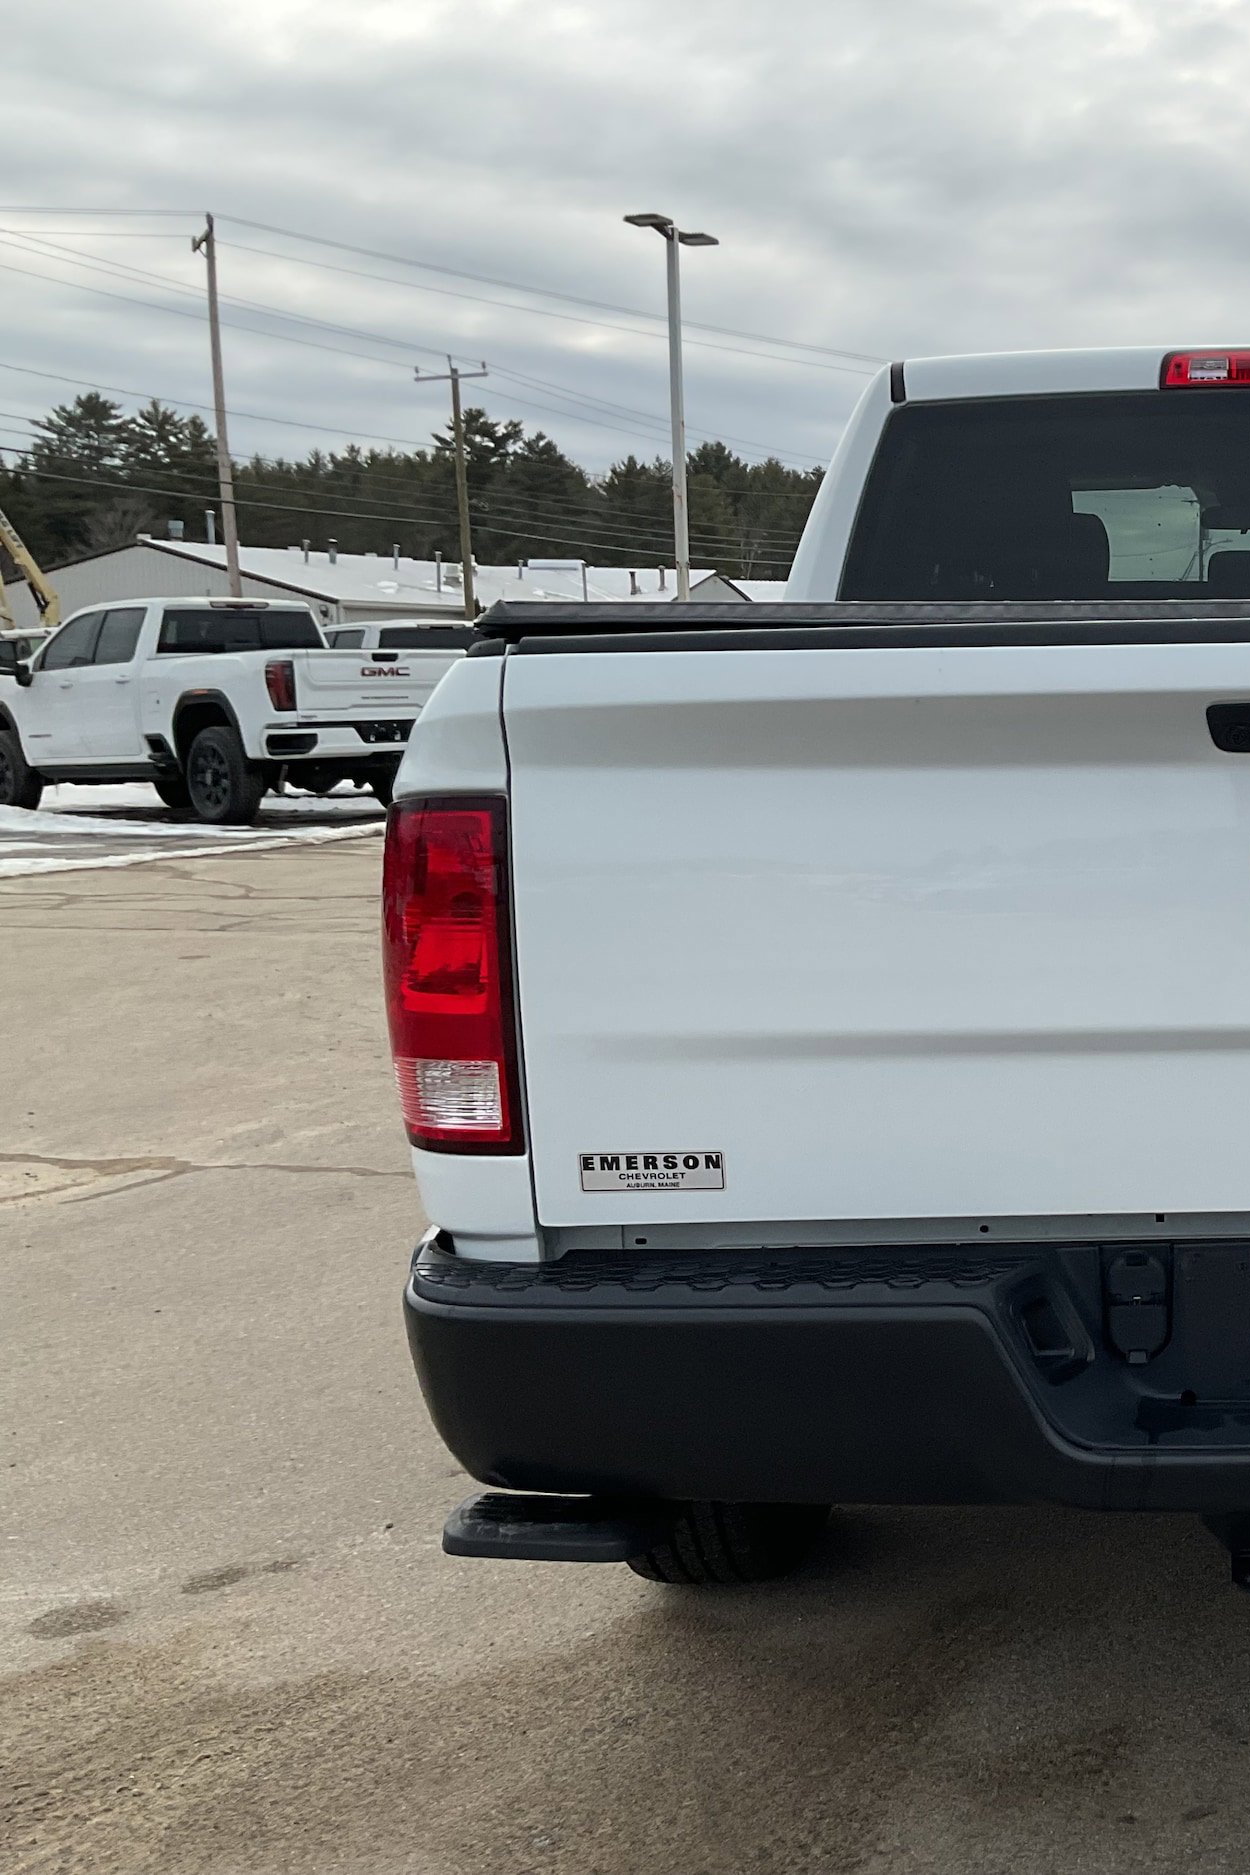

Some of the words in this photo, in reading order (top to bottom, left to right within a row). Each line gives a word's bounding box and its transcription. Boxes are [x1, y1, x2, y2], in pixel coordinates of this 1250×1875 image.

[361, 667, 410, 677] GMC
[582, 1155, 721, 1171] EMERSON
[618, 1172, 687, 1181] CHEVROLET
